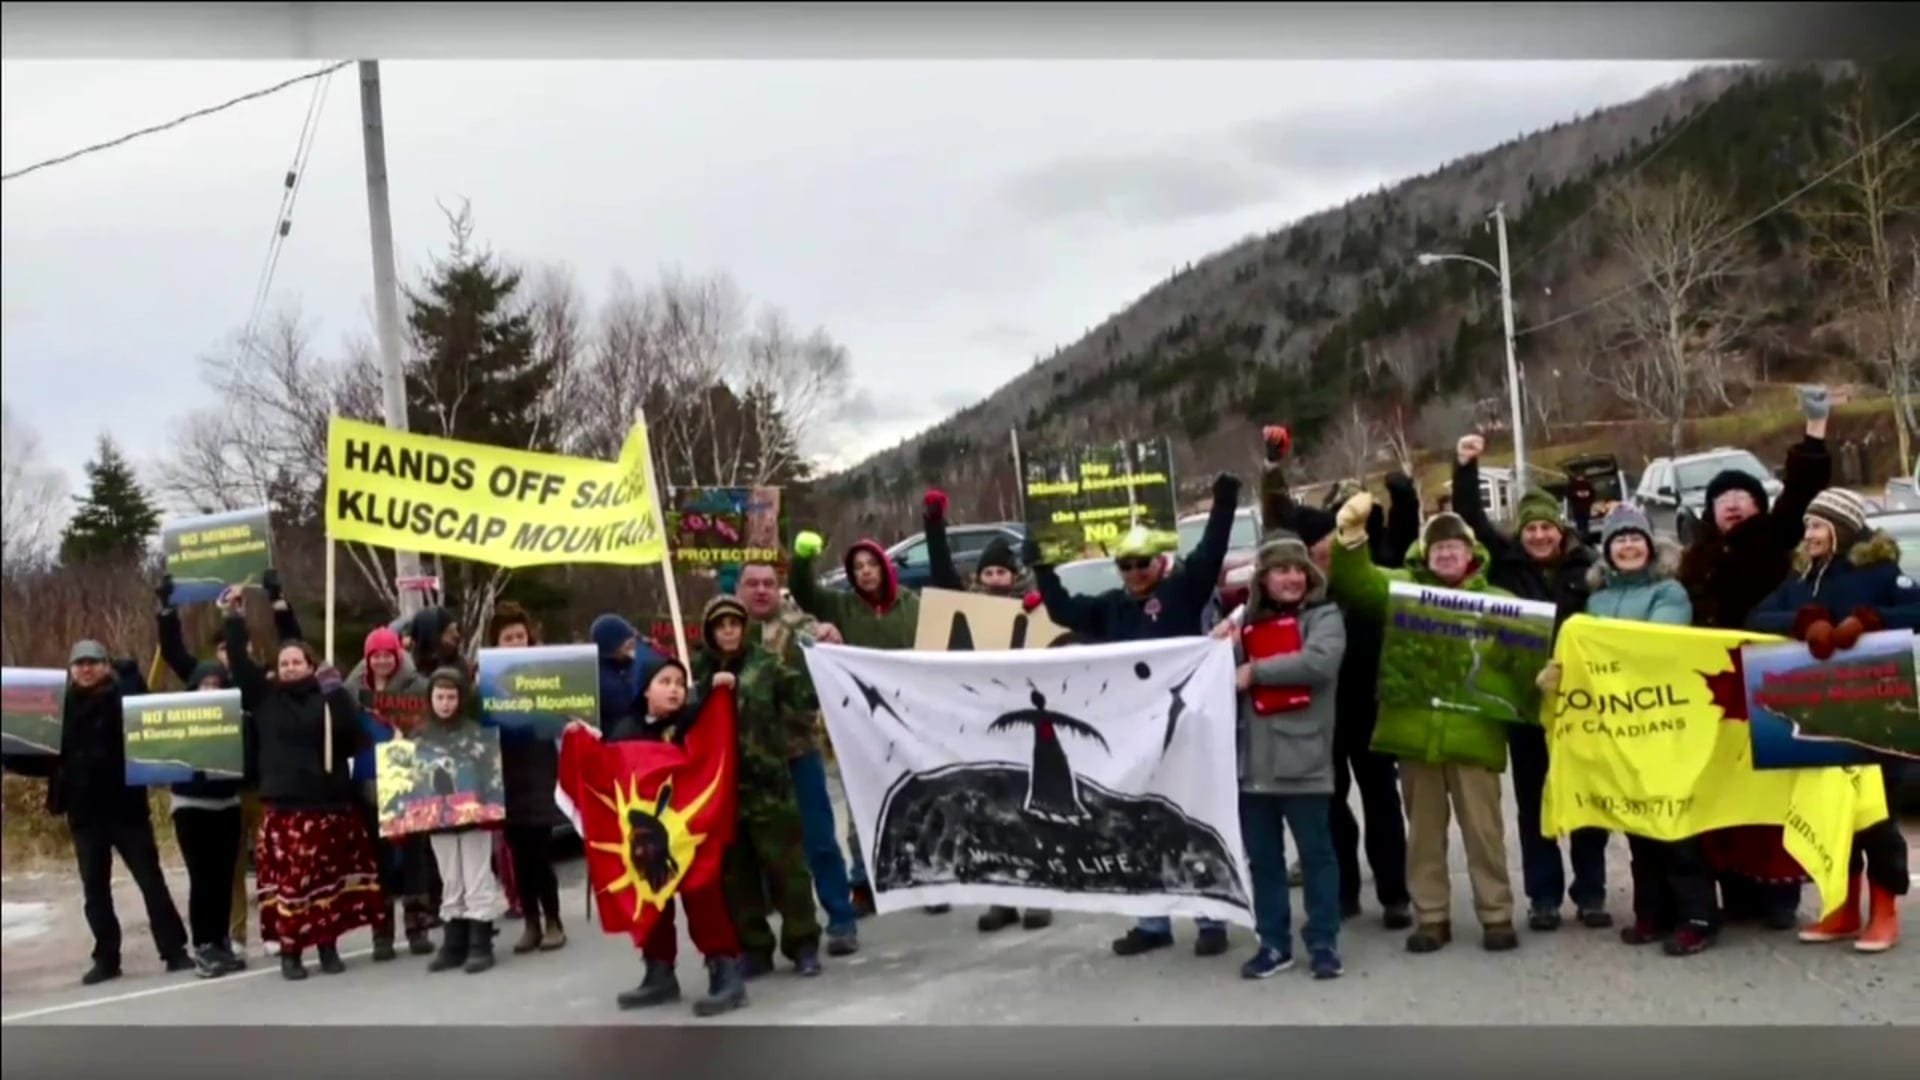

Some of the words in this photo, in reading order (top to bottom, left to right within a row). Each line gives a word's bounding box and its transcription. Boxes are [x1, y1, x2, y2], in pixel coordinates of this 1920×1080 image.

[345, 439, 476, 491] HANDS
[489, 465, 565, 504] OFF
[338, 489, 506, 546] KLUSCAP
[511, 511, 655, 552] MOUNTAIN
[1052, 511, 1076, 523] the
[179, 533, 198, 547] NO
[201, 525, 251, 544] MINING
[1084, 522, 1118, 543] NO
[677, 547, 779, 562] PROTECTED!
[1420, 589, 1485, 613] Protect
[1490, 601, 1523, 618] our
[1587, 660, 1621, 675] THE
[515, 675, 561, 691] Protect
[483, 697, 534, 713] Kluscap
[536, 694, 595, 710] Mountain
[142, 709, 163, 725] NO
[167, 705, 223, 722] MINING
[187, 724, 239, 737] Mountain
[1582, 717, 1687, 739] CAADIANS
[1047, 857, 1068, 875] IS
